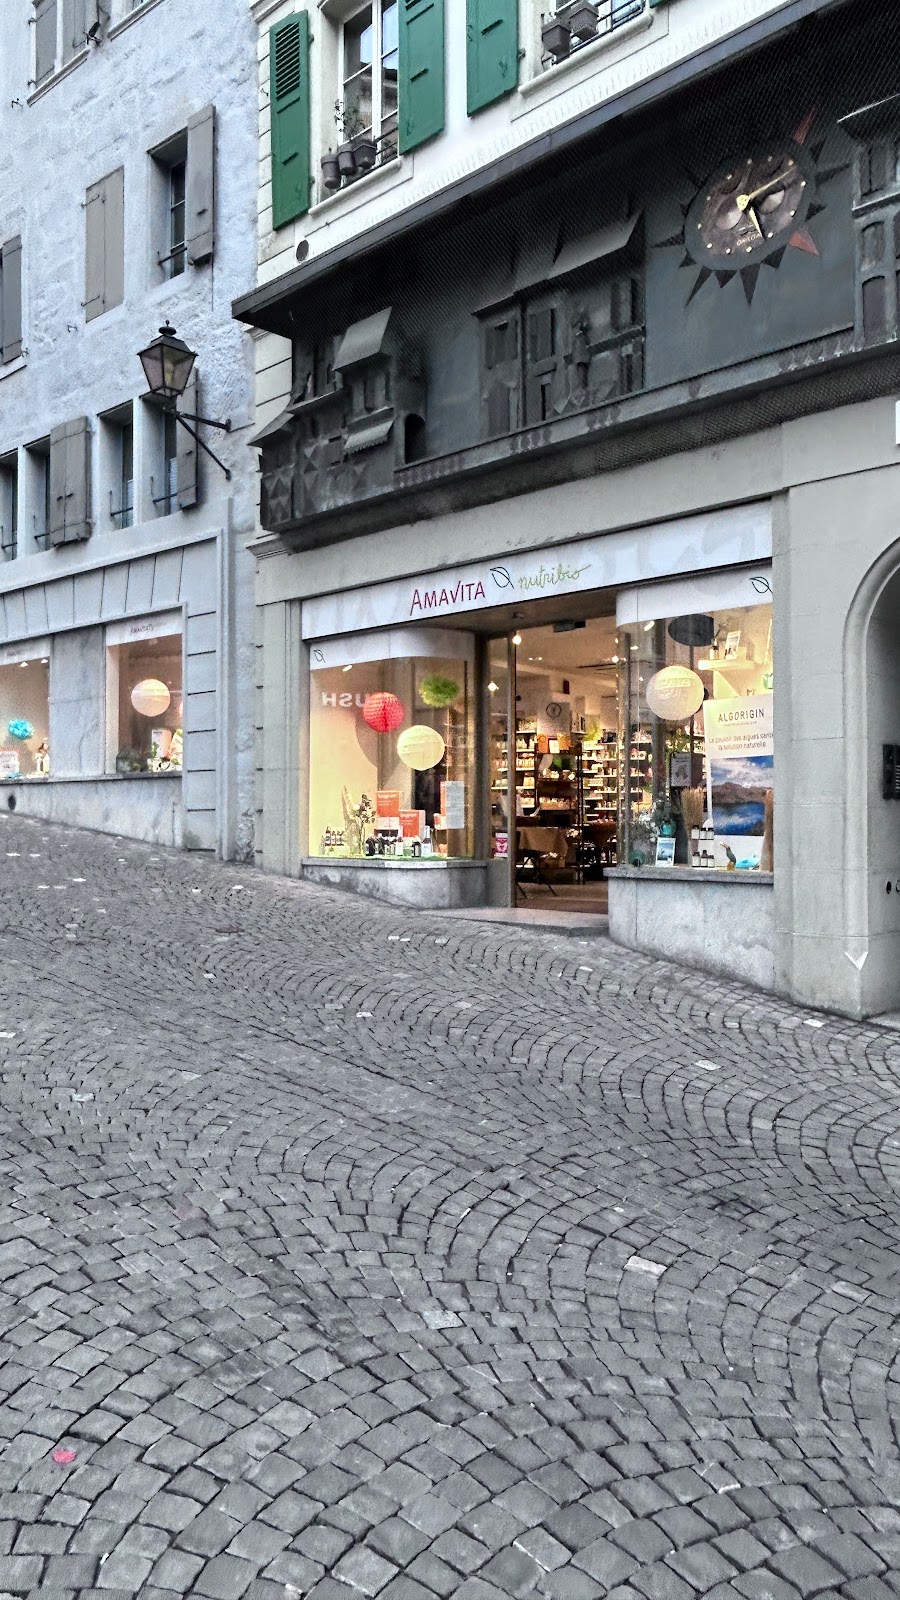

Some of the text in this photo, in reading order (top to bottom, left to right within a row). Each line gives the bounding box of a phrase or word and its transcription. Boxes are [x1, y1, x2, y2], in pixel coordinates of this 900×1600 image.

[517, 564, 592, 590] nutribio
[410, 580, 486, 616] AMAVITA
[718, 708, 764, 722] ALGORIGIN
